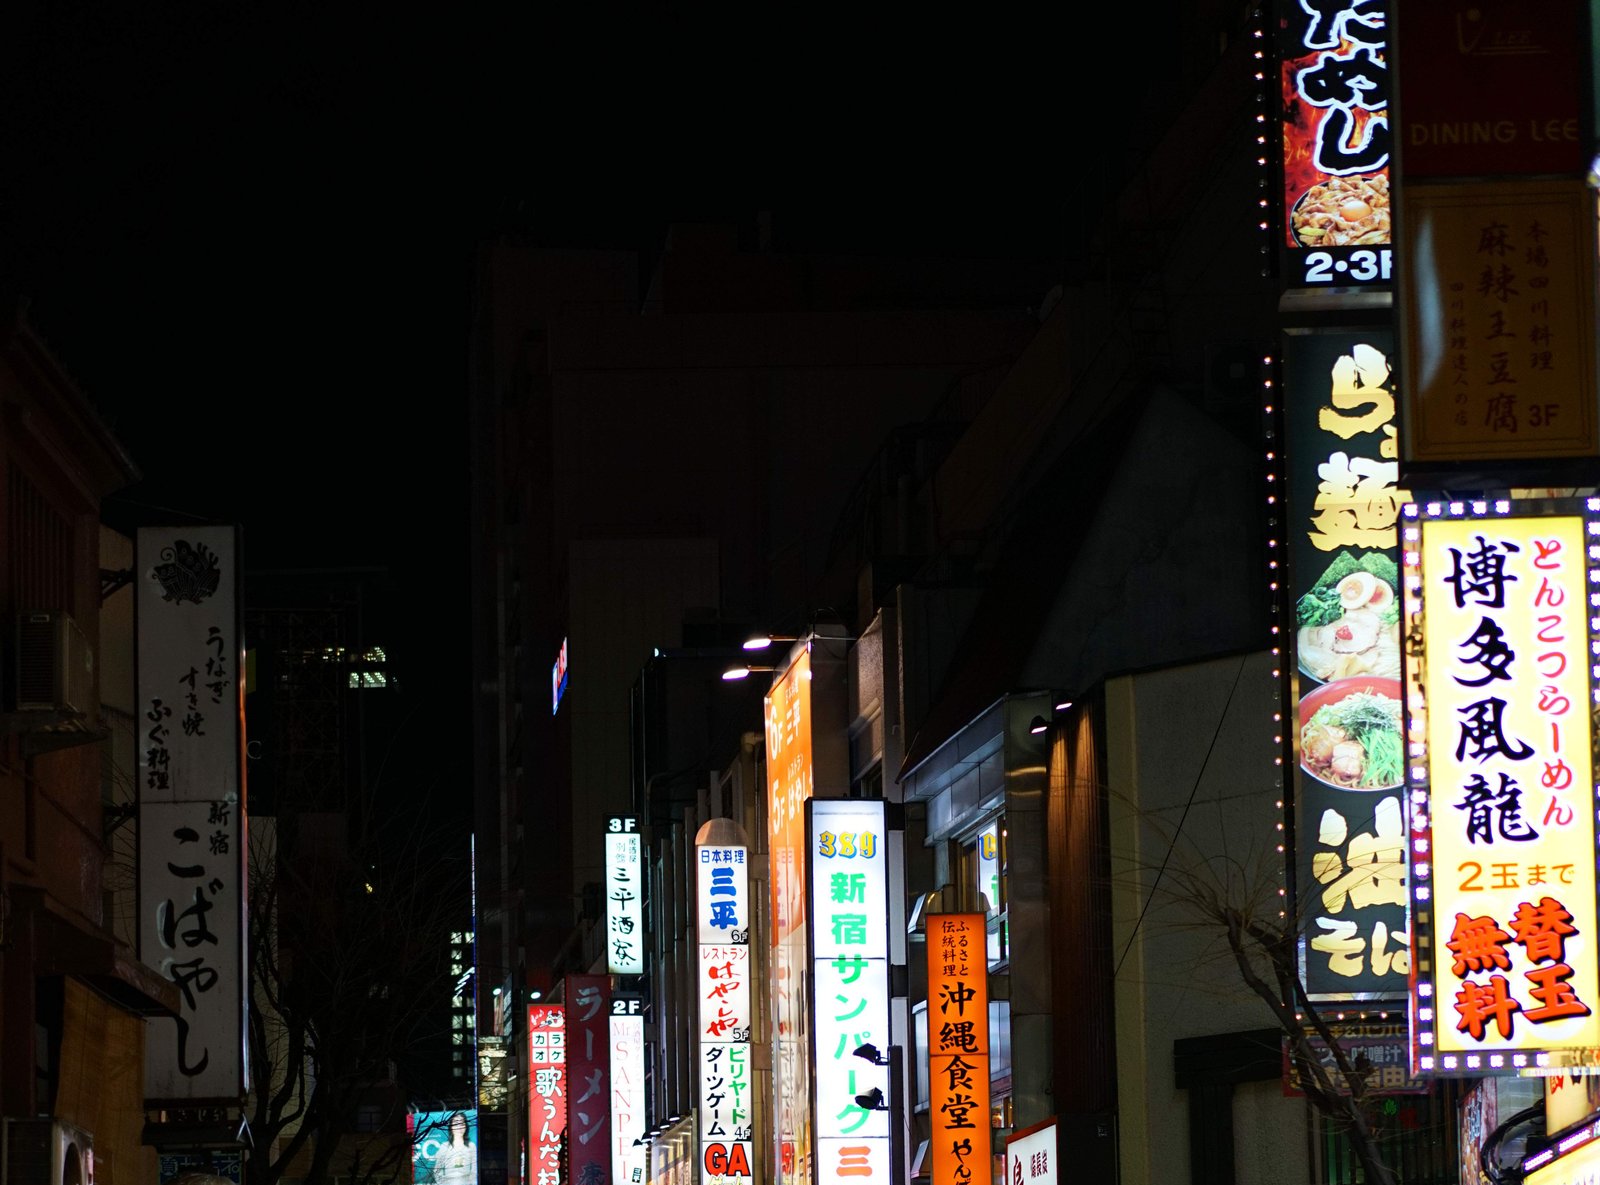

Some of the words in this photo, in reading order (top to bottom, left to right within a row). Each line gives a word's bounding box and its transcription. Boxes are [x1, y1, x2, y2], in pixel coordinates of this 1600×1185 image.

[1411, 121, 1518, 146] DINING
[1531, 118, 1580, 142] LEE
[1528, 403, 1560, 427] 3F
[1443, 536, 1540, 845] 博多風龍
[1532, 539, 1575, 827] とんこつらーめん
[207, 801, 230, 855] 新宿
[609, 818, 635, 832] 3F
[700, 850, 744, 864] 日本料理
[1457, 861, 1575, 892] 2玉まで
[709, 868, 737, 930] 三平
[702, 948, 747, 960] レストラン
[730, 930, 748, 944] 6F
[941, 920, 957, 976] 伝統料理
[956, 920, 969, 976] ふるさと
[1509, 897, 1591, 1024] 替玉
[1447, 912, 1522, 1042] 無料
[613, 1000, 640, 1014] 2F
[732, 1028, 748, 1041] 5F
[576, 986, 603, 1145] ラーメン
[939, 981, 981, 1131] 沖縄食堂
[706, 1047, 726, 1137] ダーツゲーム
[728, 1047, 748, 1125] ビリヤード
[734, 1126, 750, 1139] 4F
